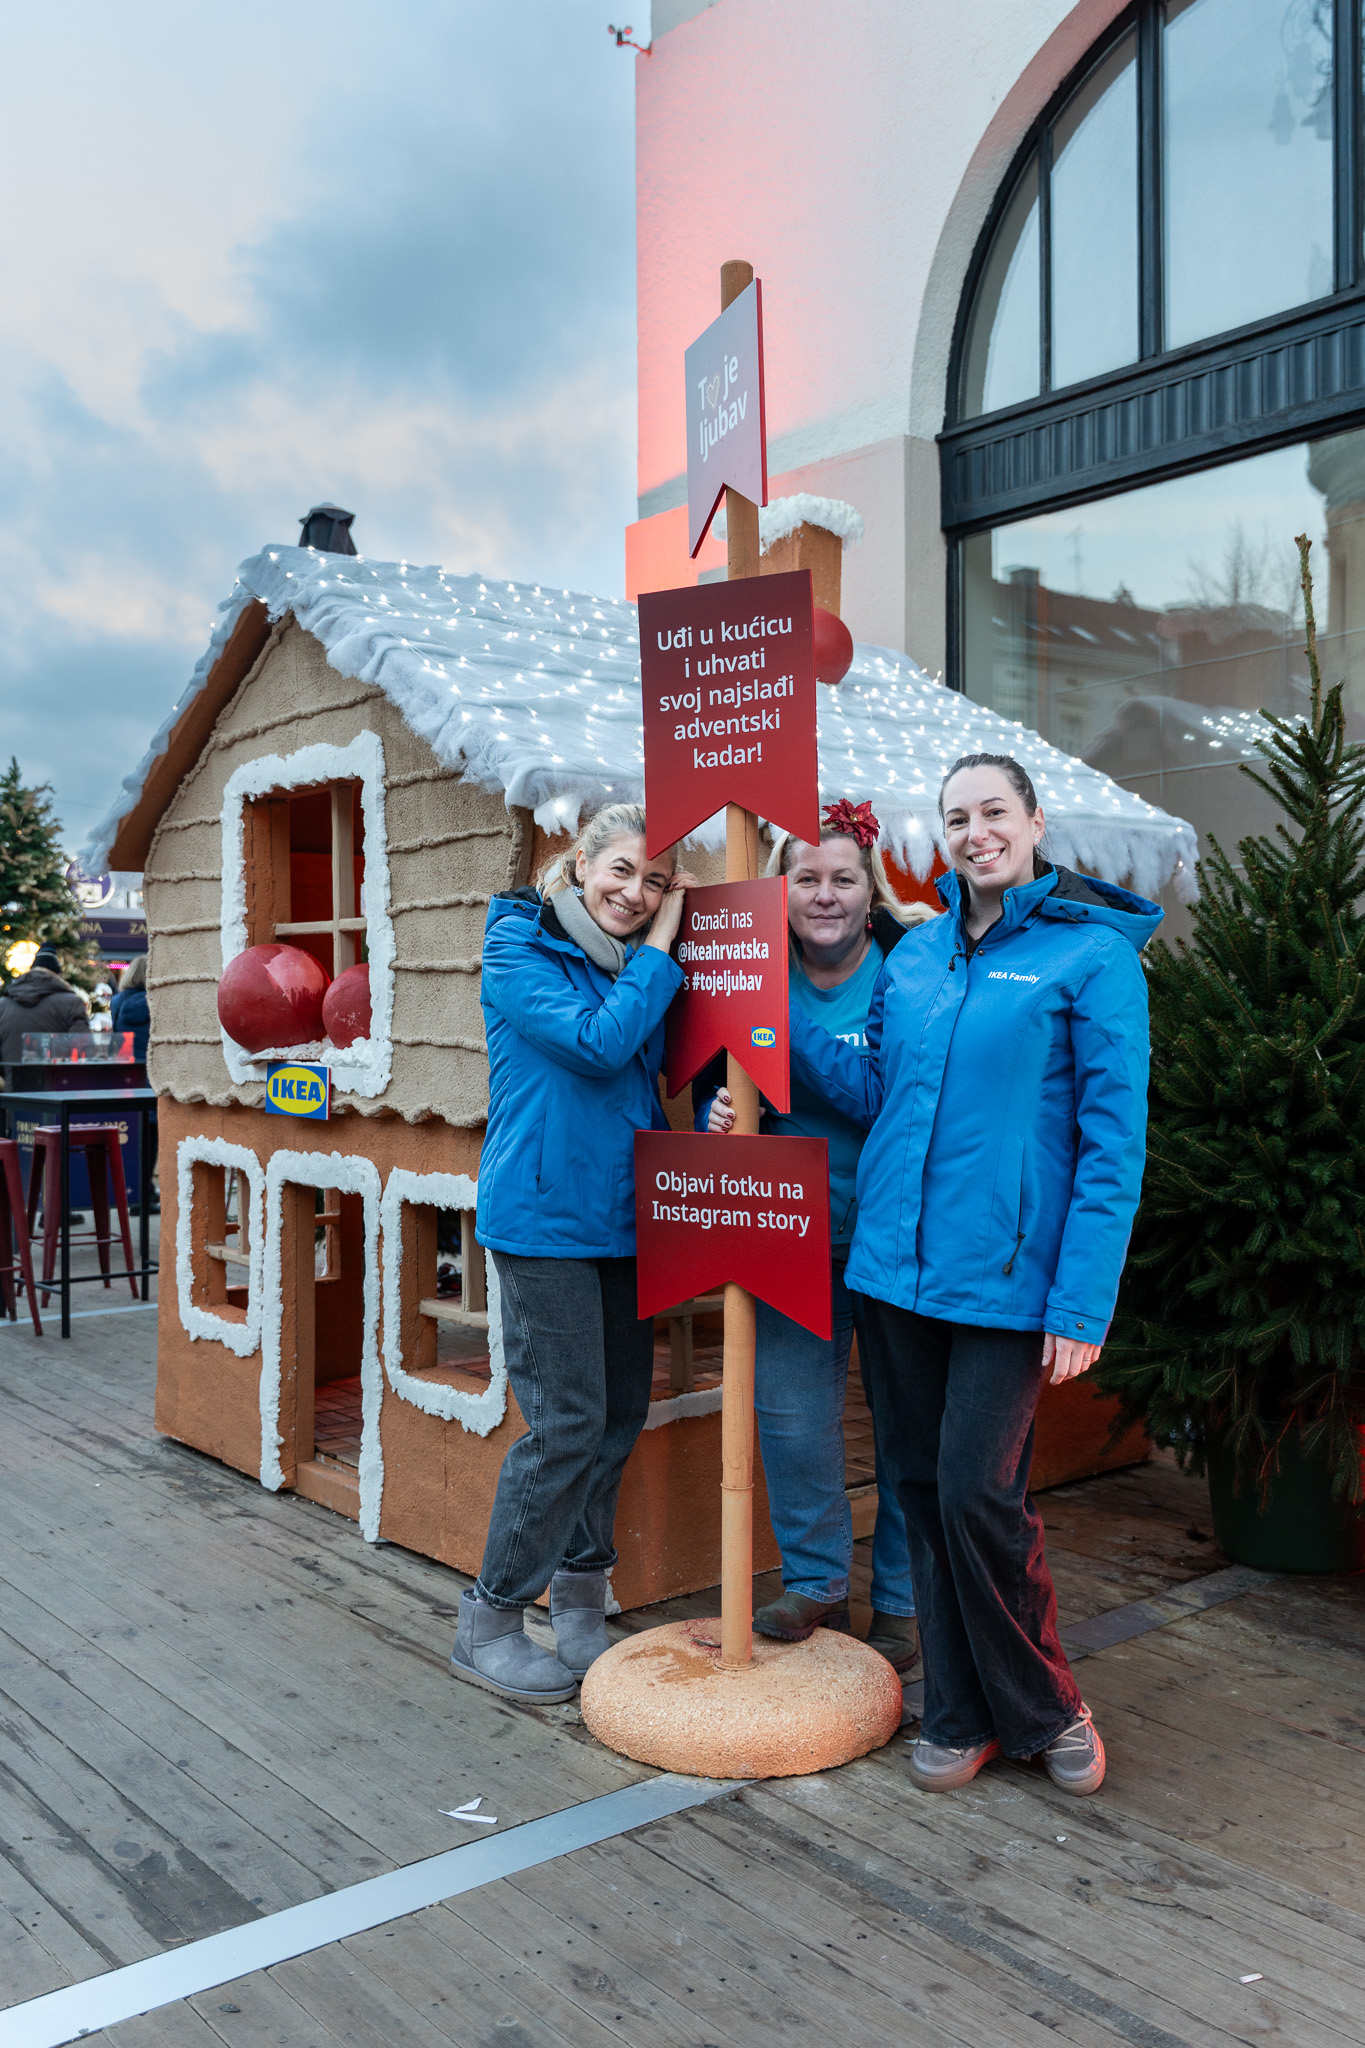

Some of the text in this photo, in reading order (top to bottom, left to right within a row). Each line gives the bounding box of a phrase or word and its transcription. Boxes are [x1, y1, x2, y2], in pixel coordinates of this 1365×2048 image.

[722, 354, 739, 402] je
[699, 391, 748, 463] ljubav
[657, 615, 793, 650] Uđi u kućicu
[684, 647, 766, 678] i uhvati
[659, 674, 794, 714] svoj najslađi
[673, 708, 781, 741] adventski
[693, 742, 763, 769] kadar!
[691, 908, 753, 931] Označi nas
[678, 938, 770, 963] @ikeahrvatska
[683, 969, 763, 997] s #tojeljubav
[987, 971, 1041, 984] IKEA Family
[753, 1032, 774, 1042] IKEA
[272, 1077, 323, 1103] IKEA
[655, 1171, 804, 1199] Objavi fotku na
[652, 1200, 811, 1237] Instagram story
